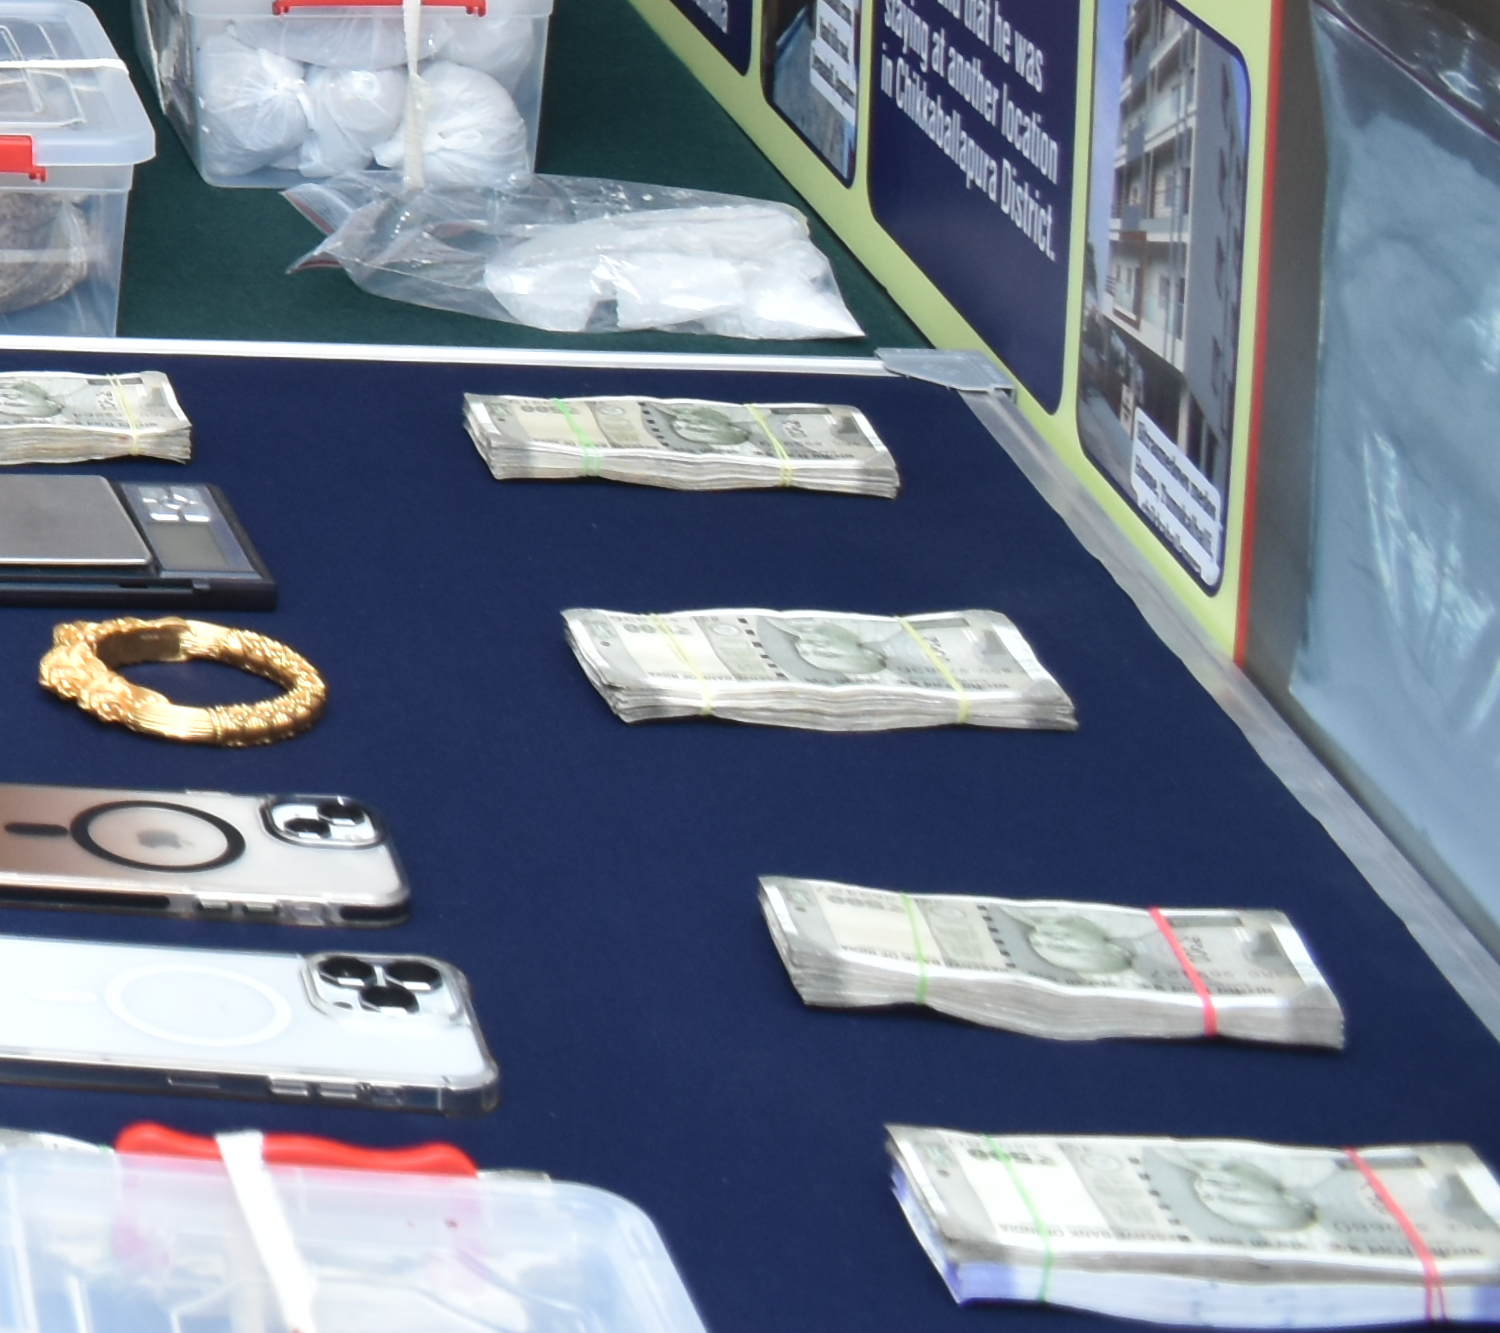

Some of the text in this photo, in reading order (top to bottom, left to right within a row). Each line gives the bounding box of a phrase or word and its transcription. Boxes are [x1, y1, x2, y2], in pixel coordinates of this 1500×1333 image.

[932, 28, 945, 77] at
[948, 45, 1000, 127] another
[1002, 83, 1058, 185] location
[994, 0, 1011, 64] he
[1014, 29, 1043, 93] was
[880, 43, 894, 99] in
[896, 57, 998, 203] Chikkaballapura
[1000, 156, 1056, 261] District.
